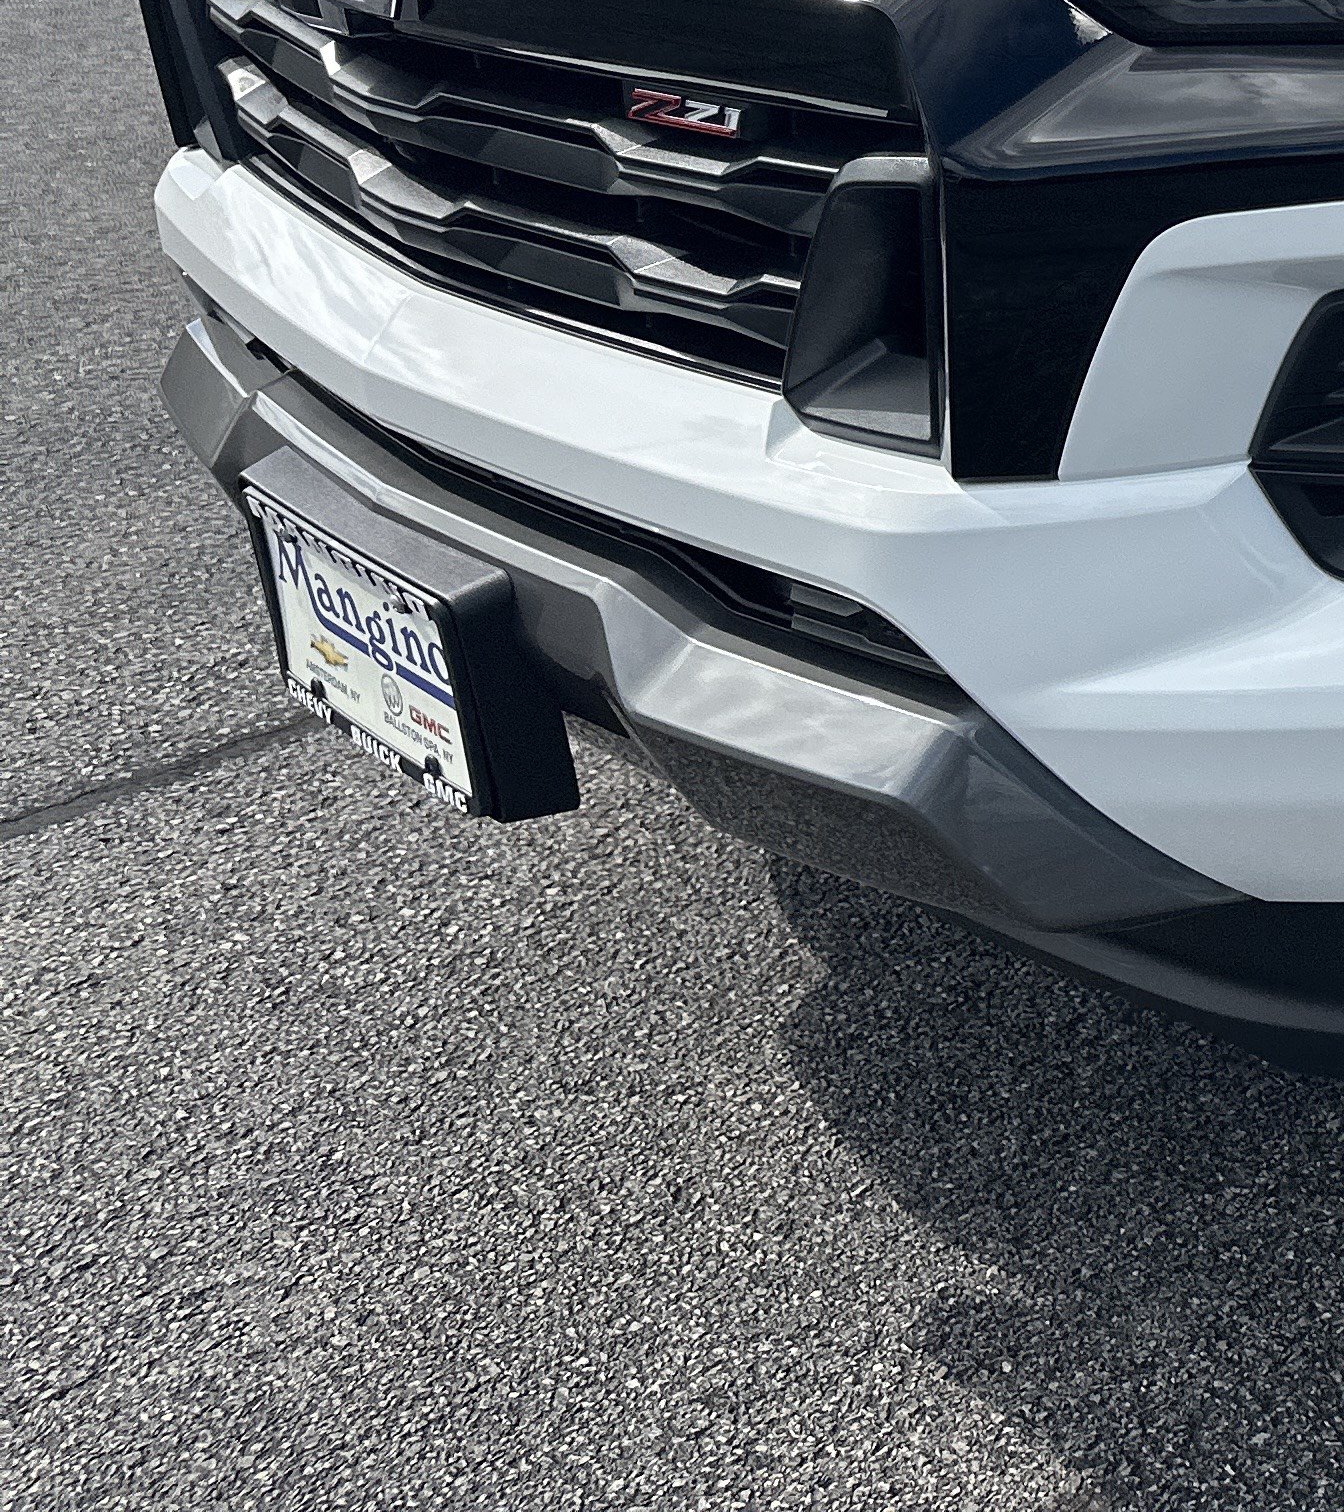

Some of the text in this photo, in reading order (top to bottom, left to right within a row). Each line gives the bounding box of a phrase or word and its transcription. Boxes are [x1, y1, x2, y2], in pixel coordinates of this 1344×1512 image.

[627, 88, 742, 138] Z71
[287, 677, 333, 725] CHEVY
[408, 703, 453, 746] GMC
[350, 724, 403, 774] BUICK
[422, 772, 468, 814] GMC
